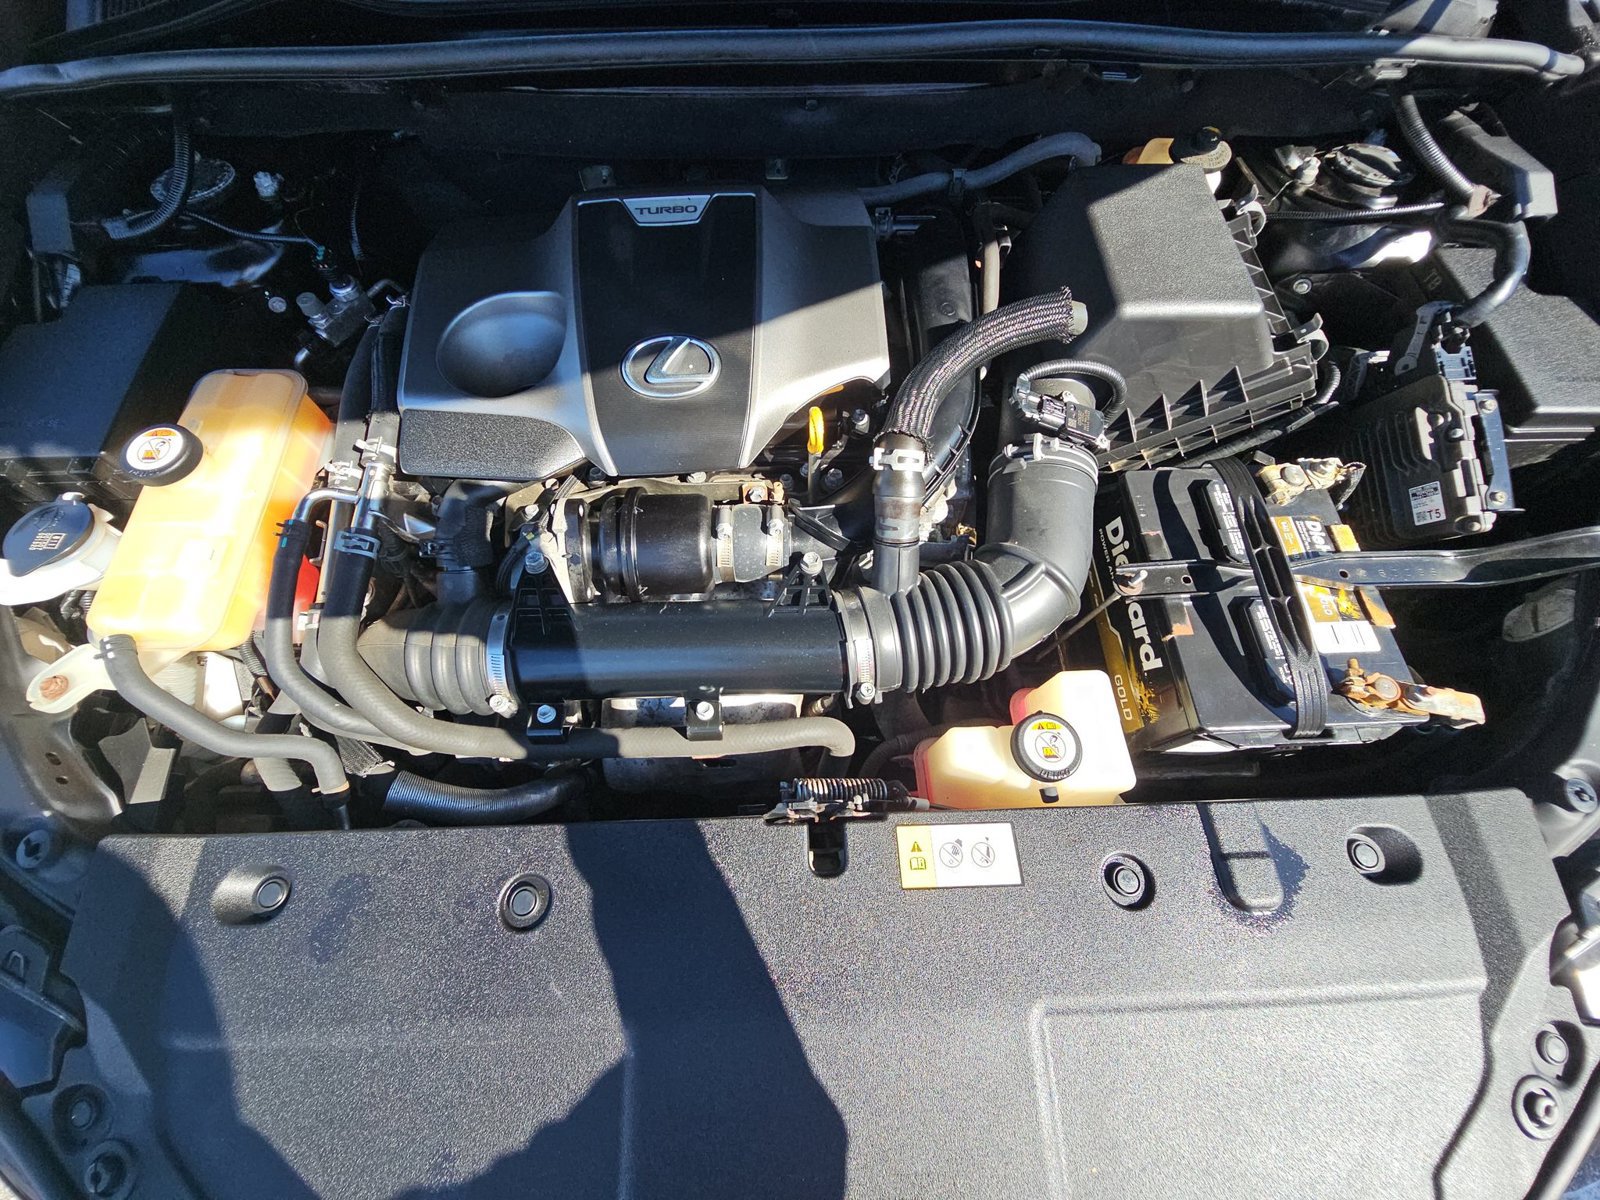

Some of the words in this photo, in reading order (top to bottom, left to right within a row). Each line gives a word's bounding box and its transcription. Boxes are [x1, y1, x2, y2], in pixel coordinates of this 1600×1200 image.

[635, 205, 698, 215] TURBO
[1098, 528, 1111, 563] POWER
[1105, 515, 1164, 672] Dieard
[1114, 674, 1133, 721] GOLD
